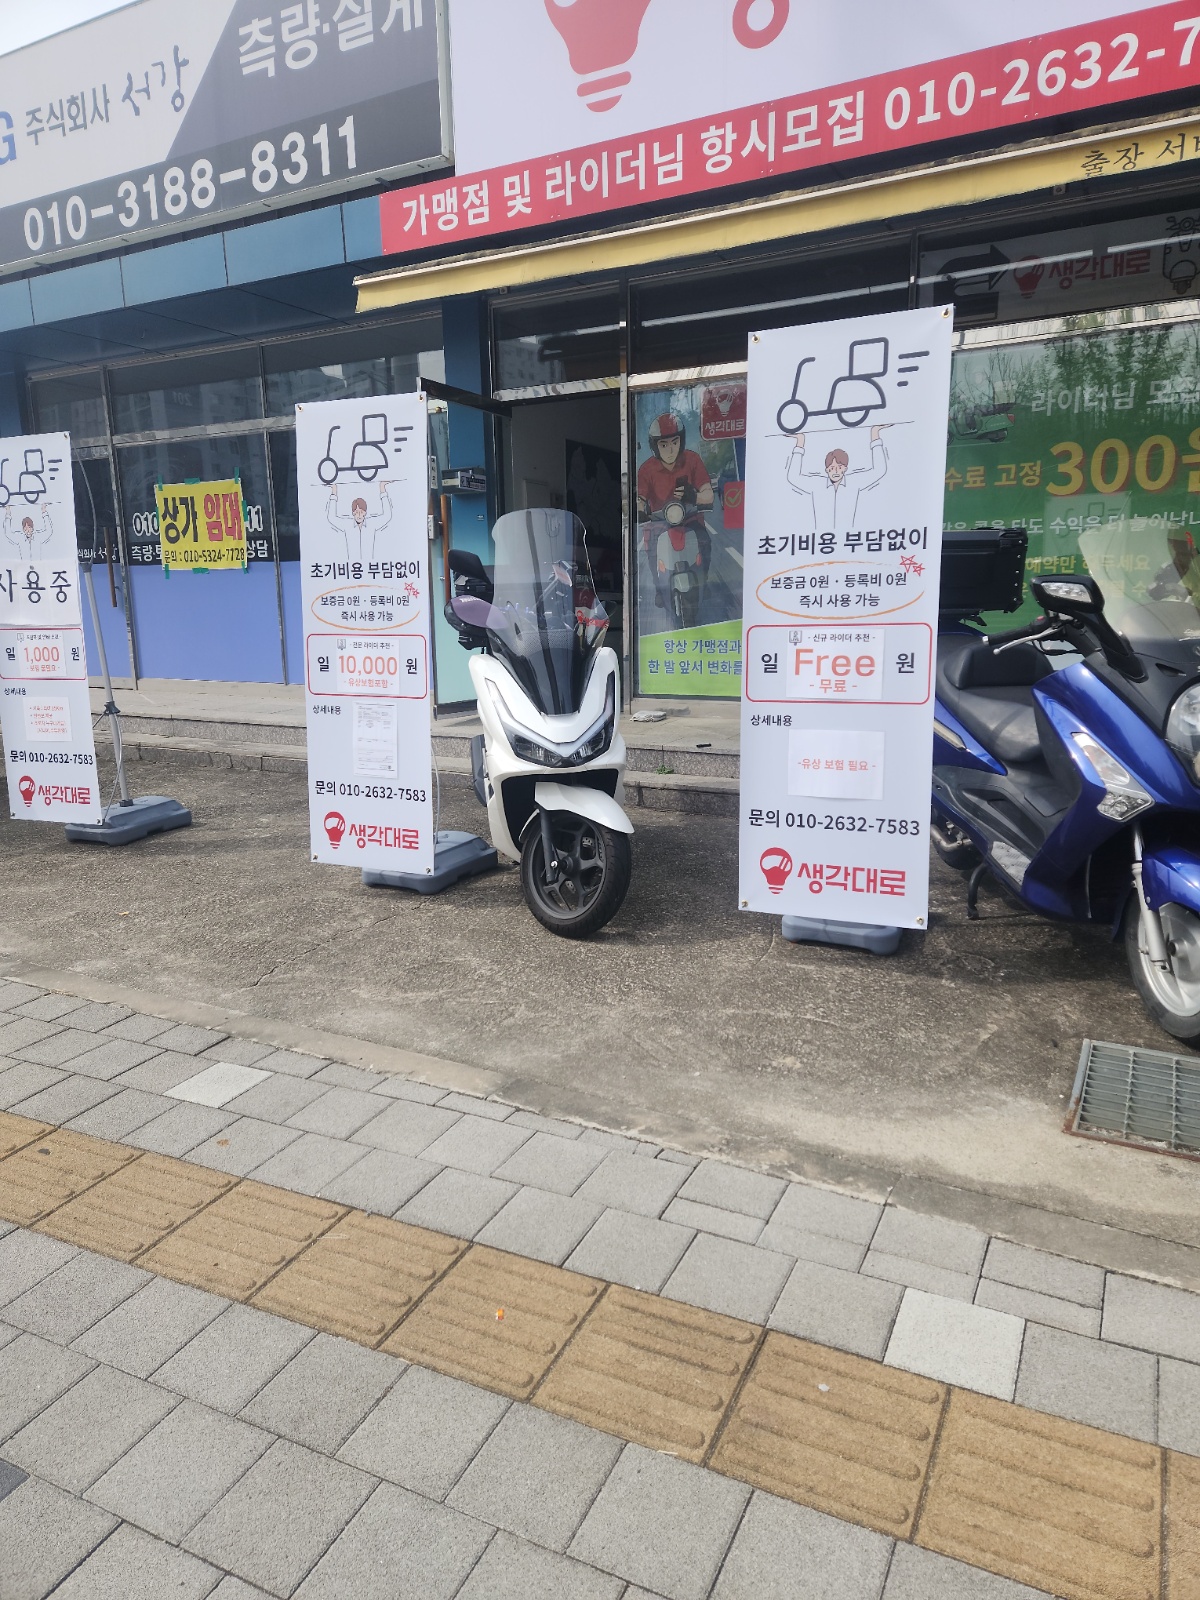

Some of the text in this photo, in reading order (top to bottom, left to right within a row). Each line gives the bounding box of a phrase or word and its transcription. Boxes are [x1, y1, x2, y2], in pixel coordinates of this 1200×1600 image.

[25, 45, 190, 146] 주식회사 서강
[402, 179, 490, 236] 가맹점
[503, 169, 533, 218] 및
[545, 133, 683, 207] 라이더님
[701, 90, 866, 175] 항시모집
[1080, 142, 1145, 177] 출장
[23, 115, 357, 251] 010-3188-8311
[1048, 249, 1151, 290] 생각대로
[1031, 378, 1136, 417] 라이더님
[705, 418, 745, 436] 생각대로
[993, 460, 1042, 487] 고정
[161, 491, 243, 544] 상가 임대
[1049, 514, 1102, 535] 수익은
[757, 526, 928, 556] 초기비용 부담없이
[310, 560, 421, 580] 초기비용 부담없이
[770, 572, 907, 590] 보증금 0원 등록비 0원
[320, 594, 410, 607] 보증금 0원 등록비 0원
[799, 593, 880, 608] 즉시 사용 가능
[341, 610, 394, 622] 즉시 사용 가능
[663, 639, 742, 655] 항상 가맹점과
[813, 633, 870, 643] 신규 라이더 추천
[5, 645, 80, 664] 일 1,000 원
[761, 648, 915, 677] 일 Free 원
[317, 655, 418, 676] 일 10,000 원
[648, 659, 660, 675] 한
[664, 660, 675, 674] 발
[679, 660, 703, 675] 앞서
[819, 678, 847, 694] 무료
[312, 704, 342, 716] 상세내용
[750, 714, 793, 727] 상세내용
[10, 750, 94, 765] 문의 010-2632-7583
[824, 759, 844, 771] 보험
[848, 760, 869, 772] 필요
[38, 784, 91, 806] 생각대로
[315, 780, 427, 802] 문의 010-2632-7583
[748, 808, 921, 836] 문의 010-2632-7583
[349, 823, 419, 851] 생각대로
[797, 862, 906, 897] 생각대로
